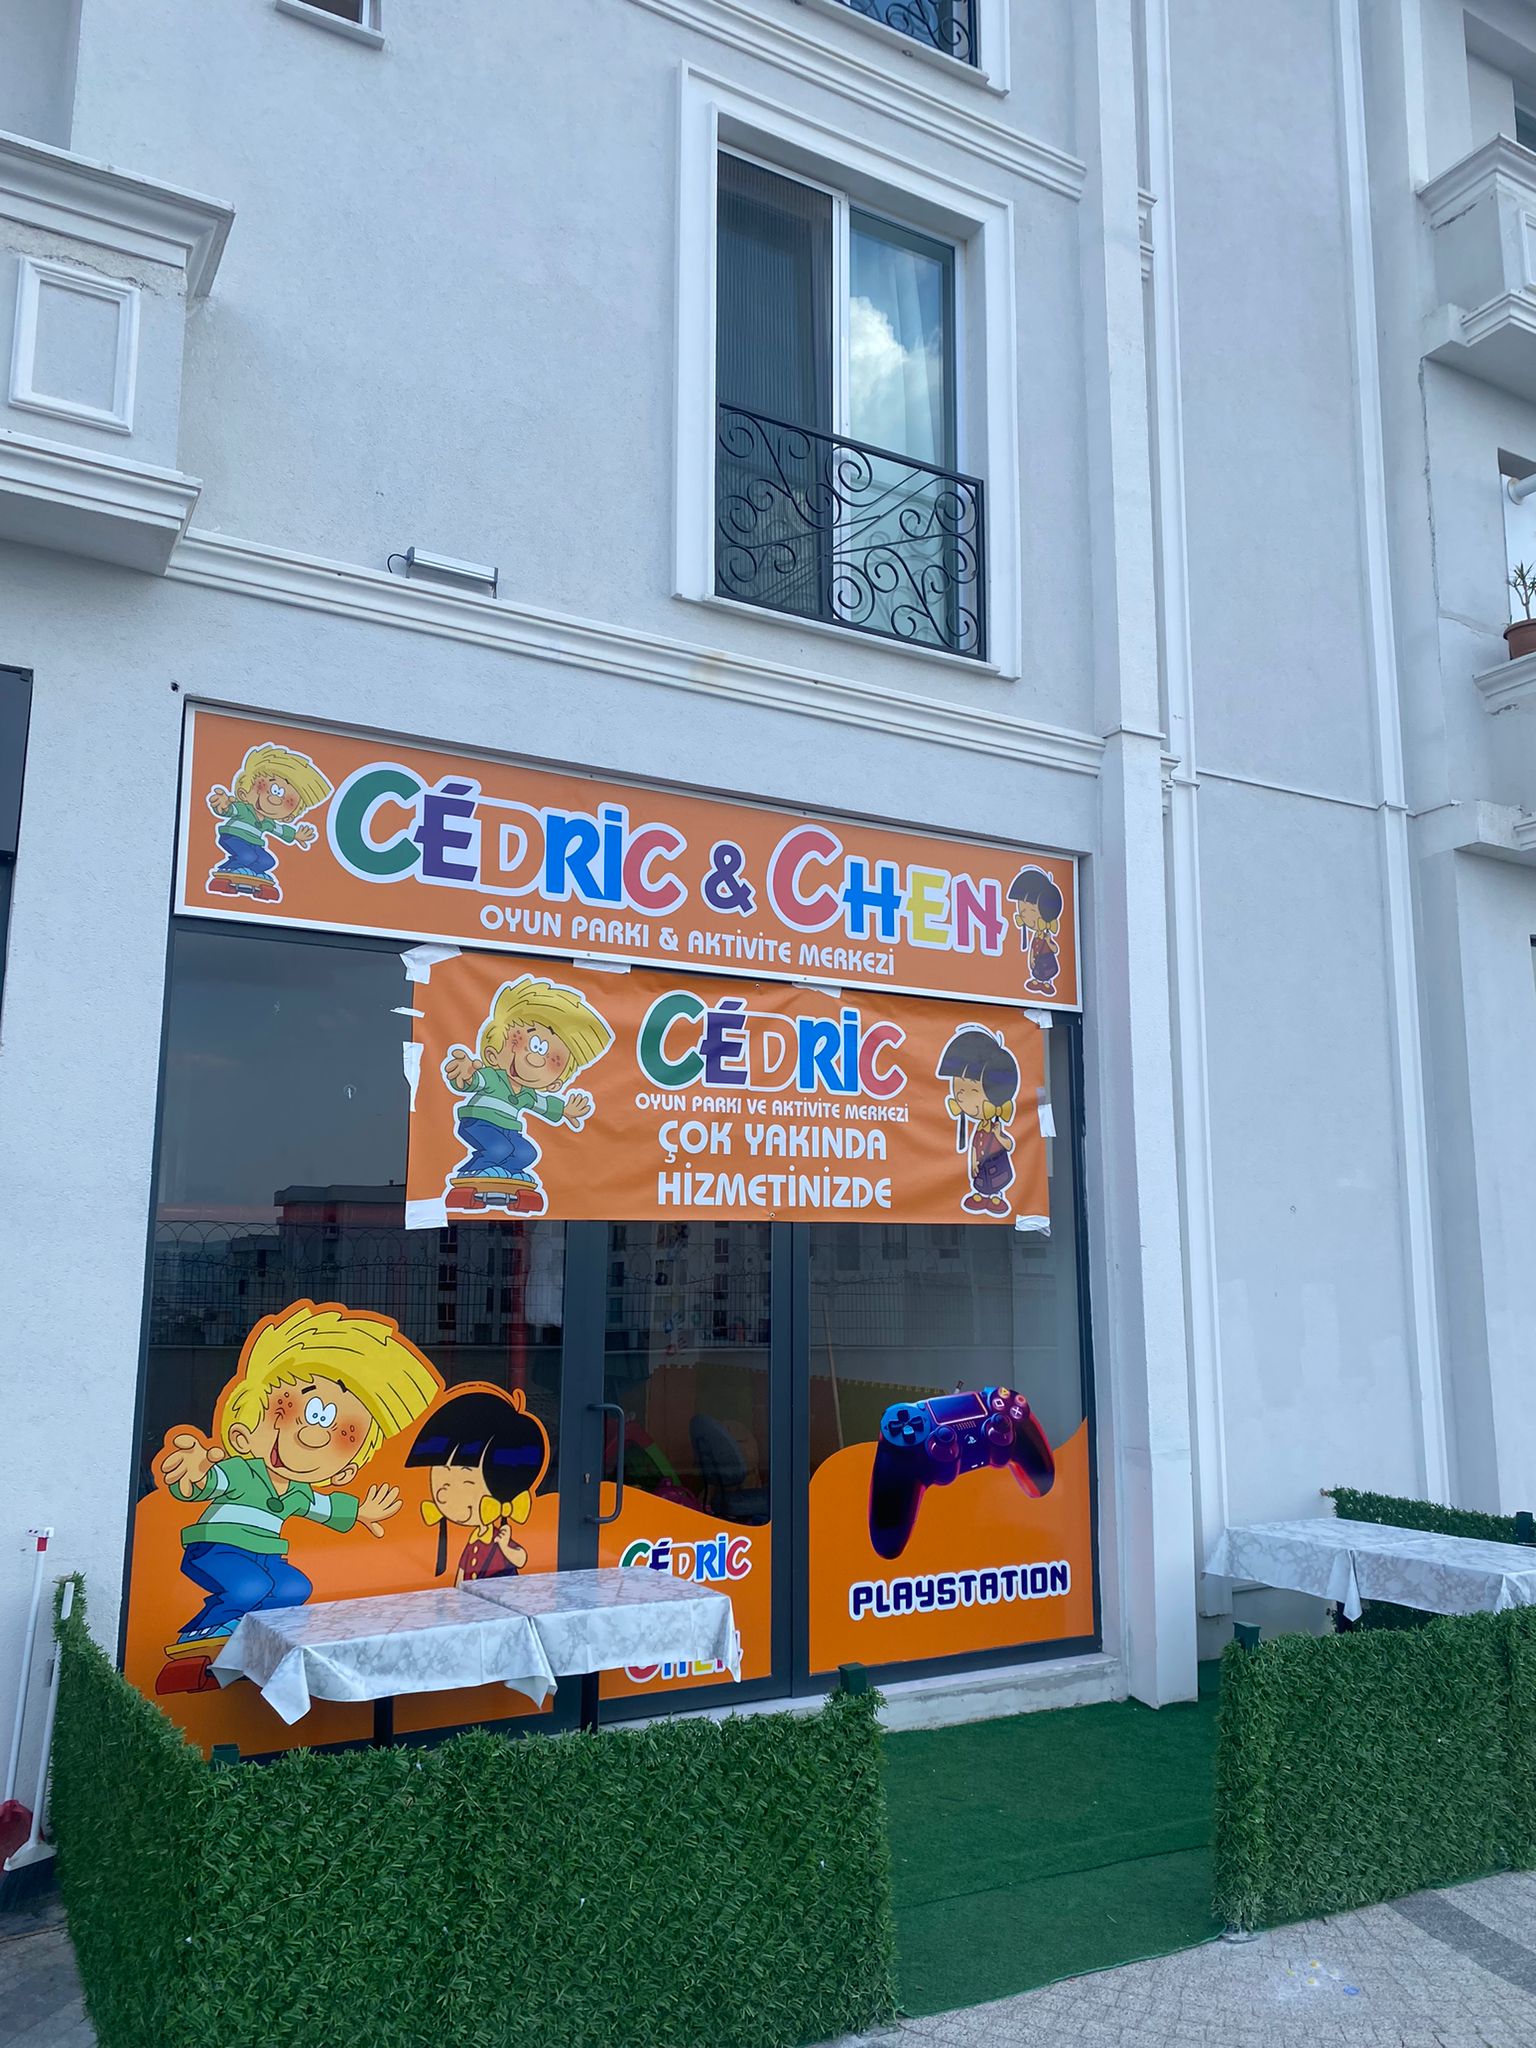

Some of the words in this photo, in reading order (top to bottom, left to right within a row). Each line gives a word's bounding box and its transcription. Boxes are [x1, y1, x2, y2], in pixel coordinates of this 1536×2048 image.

[701, 840, 756, 917] &
[766, 824, 1008, 956] CHEN
[479, 904, 562, 937] OYUN
[572, 915, 650, 947] PARKI
[658, 926, 680, 952] &
[688, 929, 792, 965] AKTİVİTE
[800, 942, 895, 976] MERKEZİ
[635, 1091, 687, 1112] OYUN
[692, 1096, 742, 1115] PARKI
[747, 1099, 767, 1116] VE
[772, 1097, 840, 1119] AKTİVİTE
[844, 1102, 909, 1123] MERKEZİ
[658, 1120, 732, 1164] ÇOK
[744, 1123, 888, 1160] YAKINDA
[658, 1161, 892, 1209] HİZMETİNİZDE
[849, 1559, 1071, 1621] PLAYSTATION
